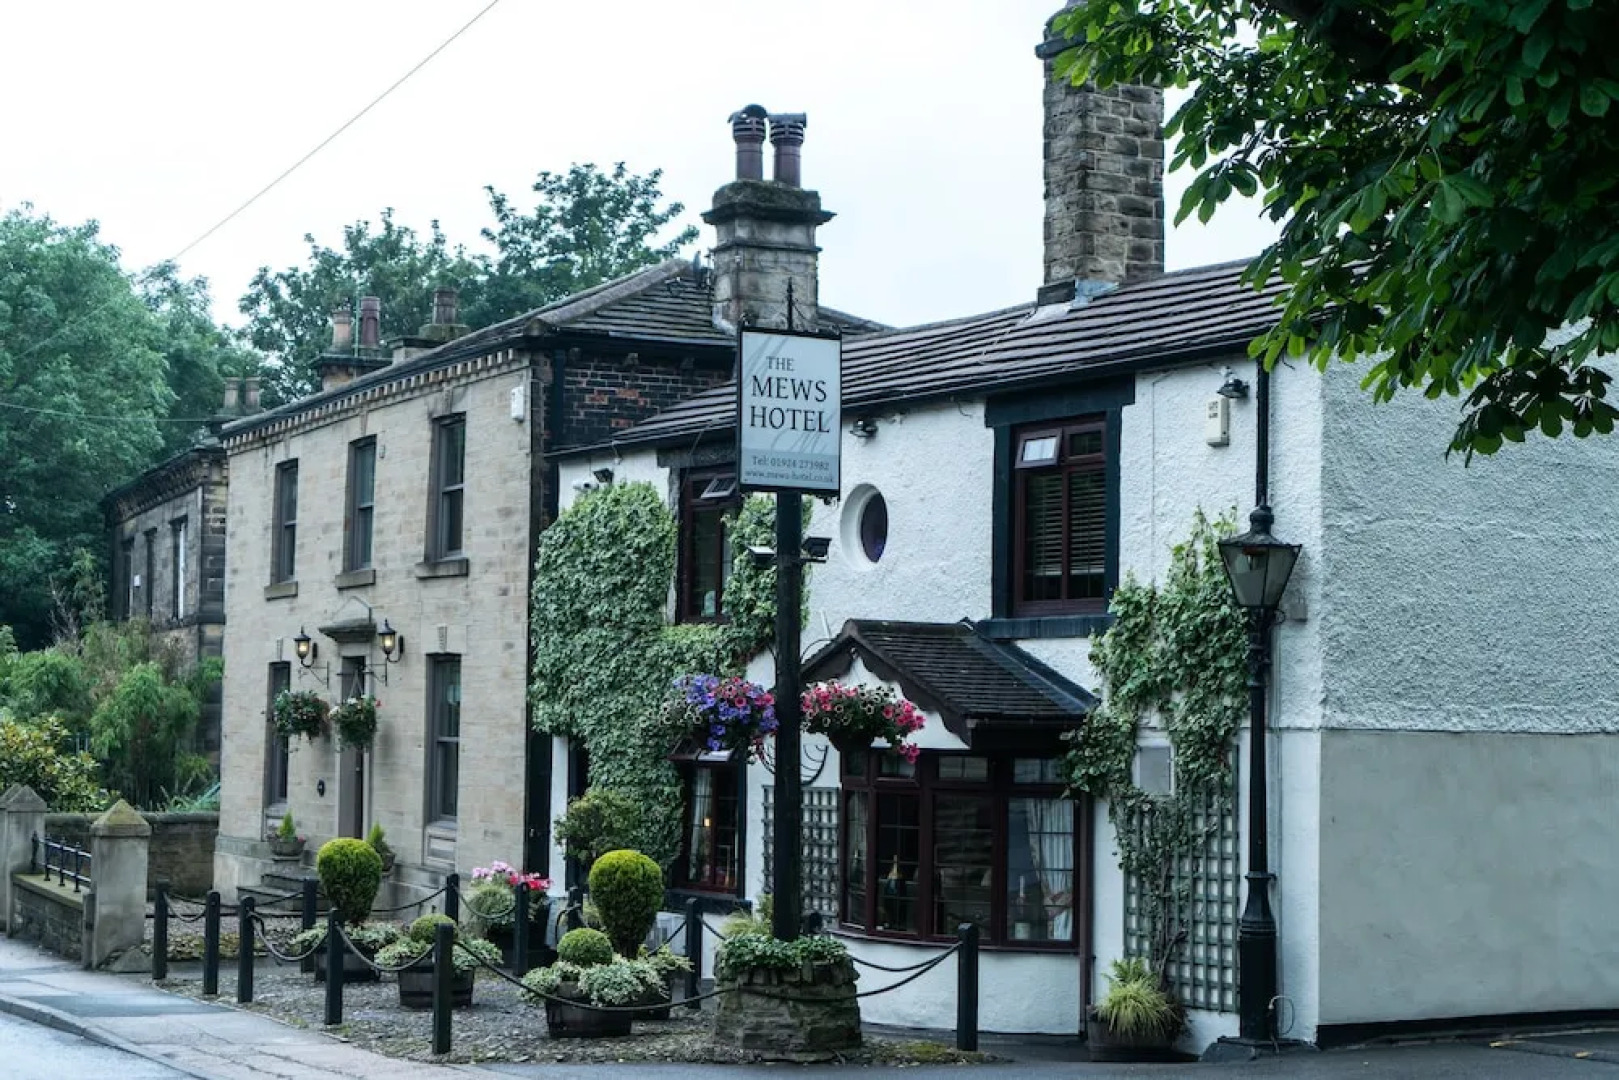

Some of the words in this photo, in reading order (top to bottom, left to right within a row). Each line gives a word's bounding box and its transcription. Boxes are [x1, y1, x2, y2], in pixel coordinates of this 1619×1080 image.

[766, 356, 795, 372] THE
[751, 375, 827, 402] MEWS
[750, 405, 830, 433] HOTEL
